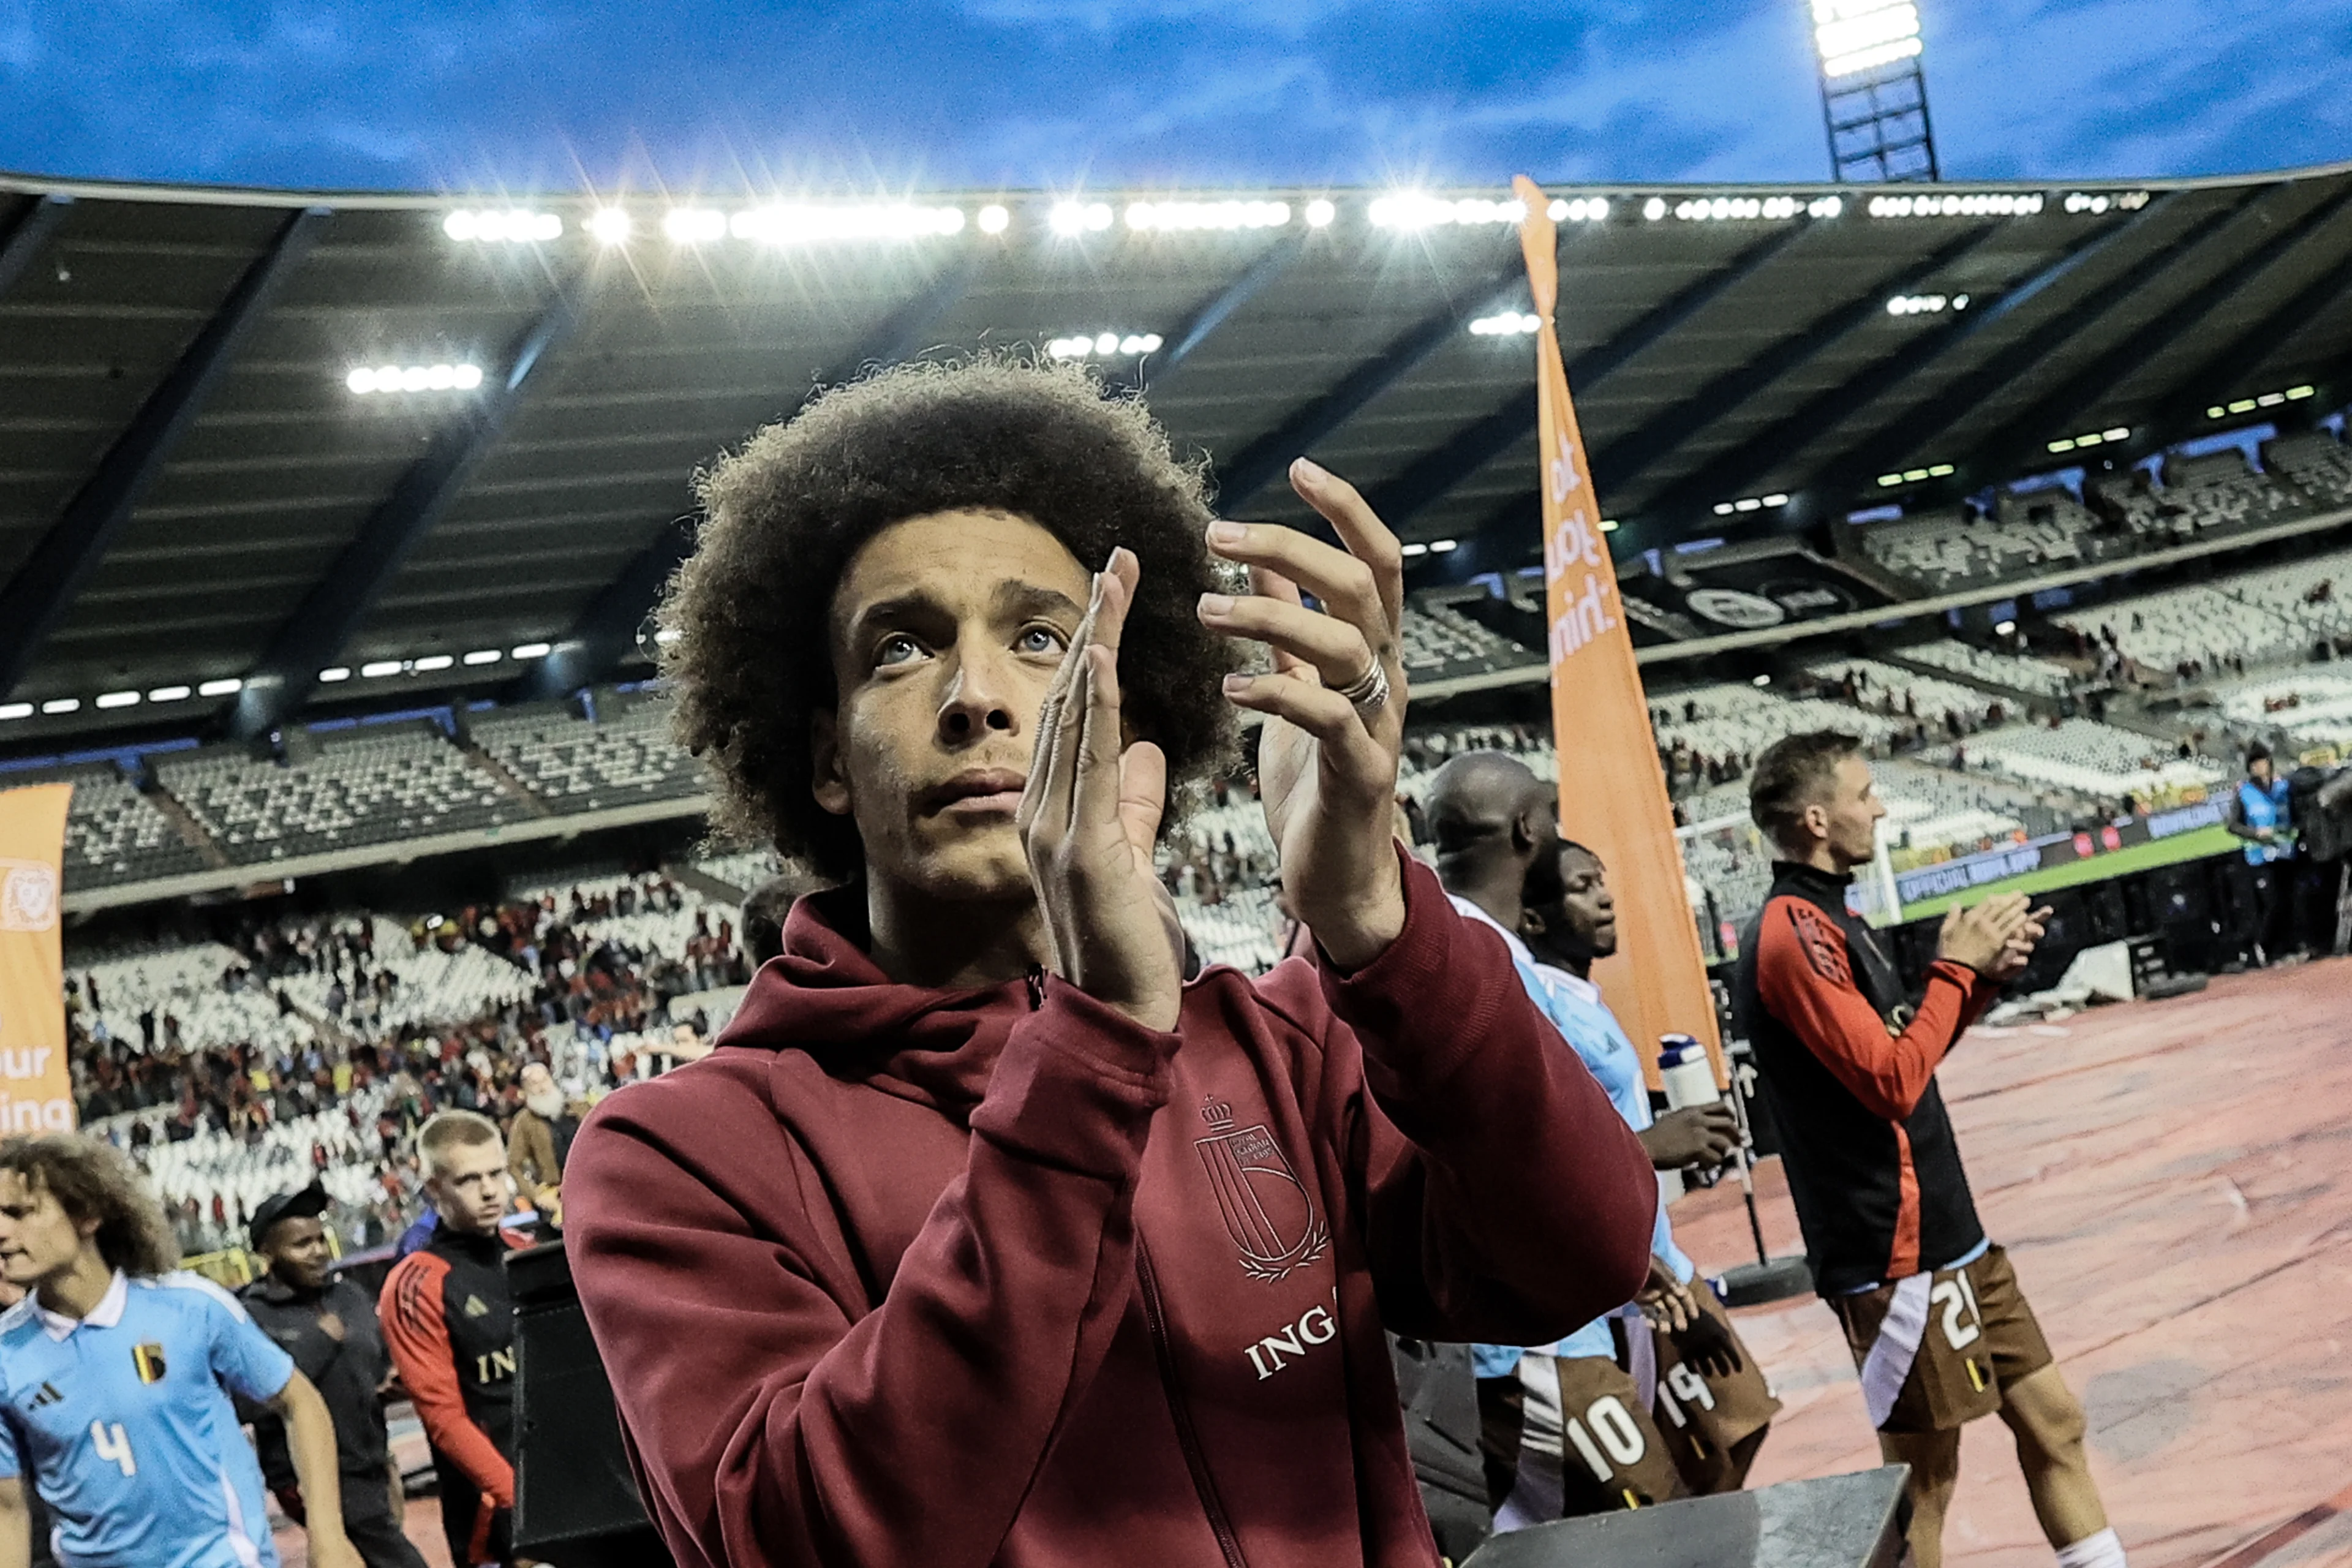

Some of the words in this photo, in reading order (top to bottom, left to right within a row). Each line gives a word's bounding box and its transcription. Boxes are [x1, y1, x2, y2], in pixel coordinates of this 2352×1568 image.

[0, 1045, 52, 1079] ur
[0, 1090, 72, 1133] ing
[1931, 1268, 1982, 1350] 21
[477, 1345, 516, 1384] IN
[1244, 1305, 1336, 1381] ING
[1657, 1361, 1715, 1428] 19
[89, 1419, 138, 1477] 4
[1566, 1395, 1645, 1483] 10
